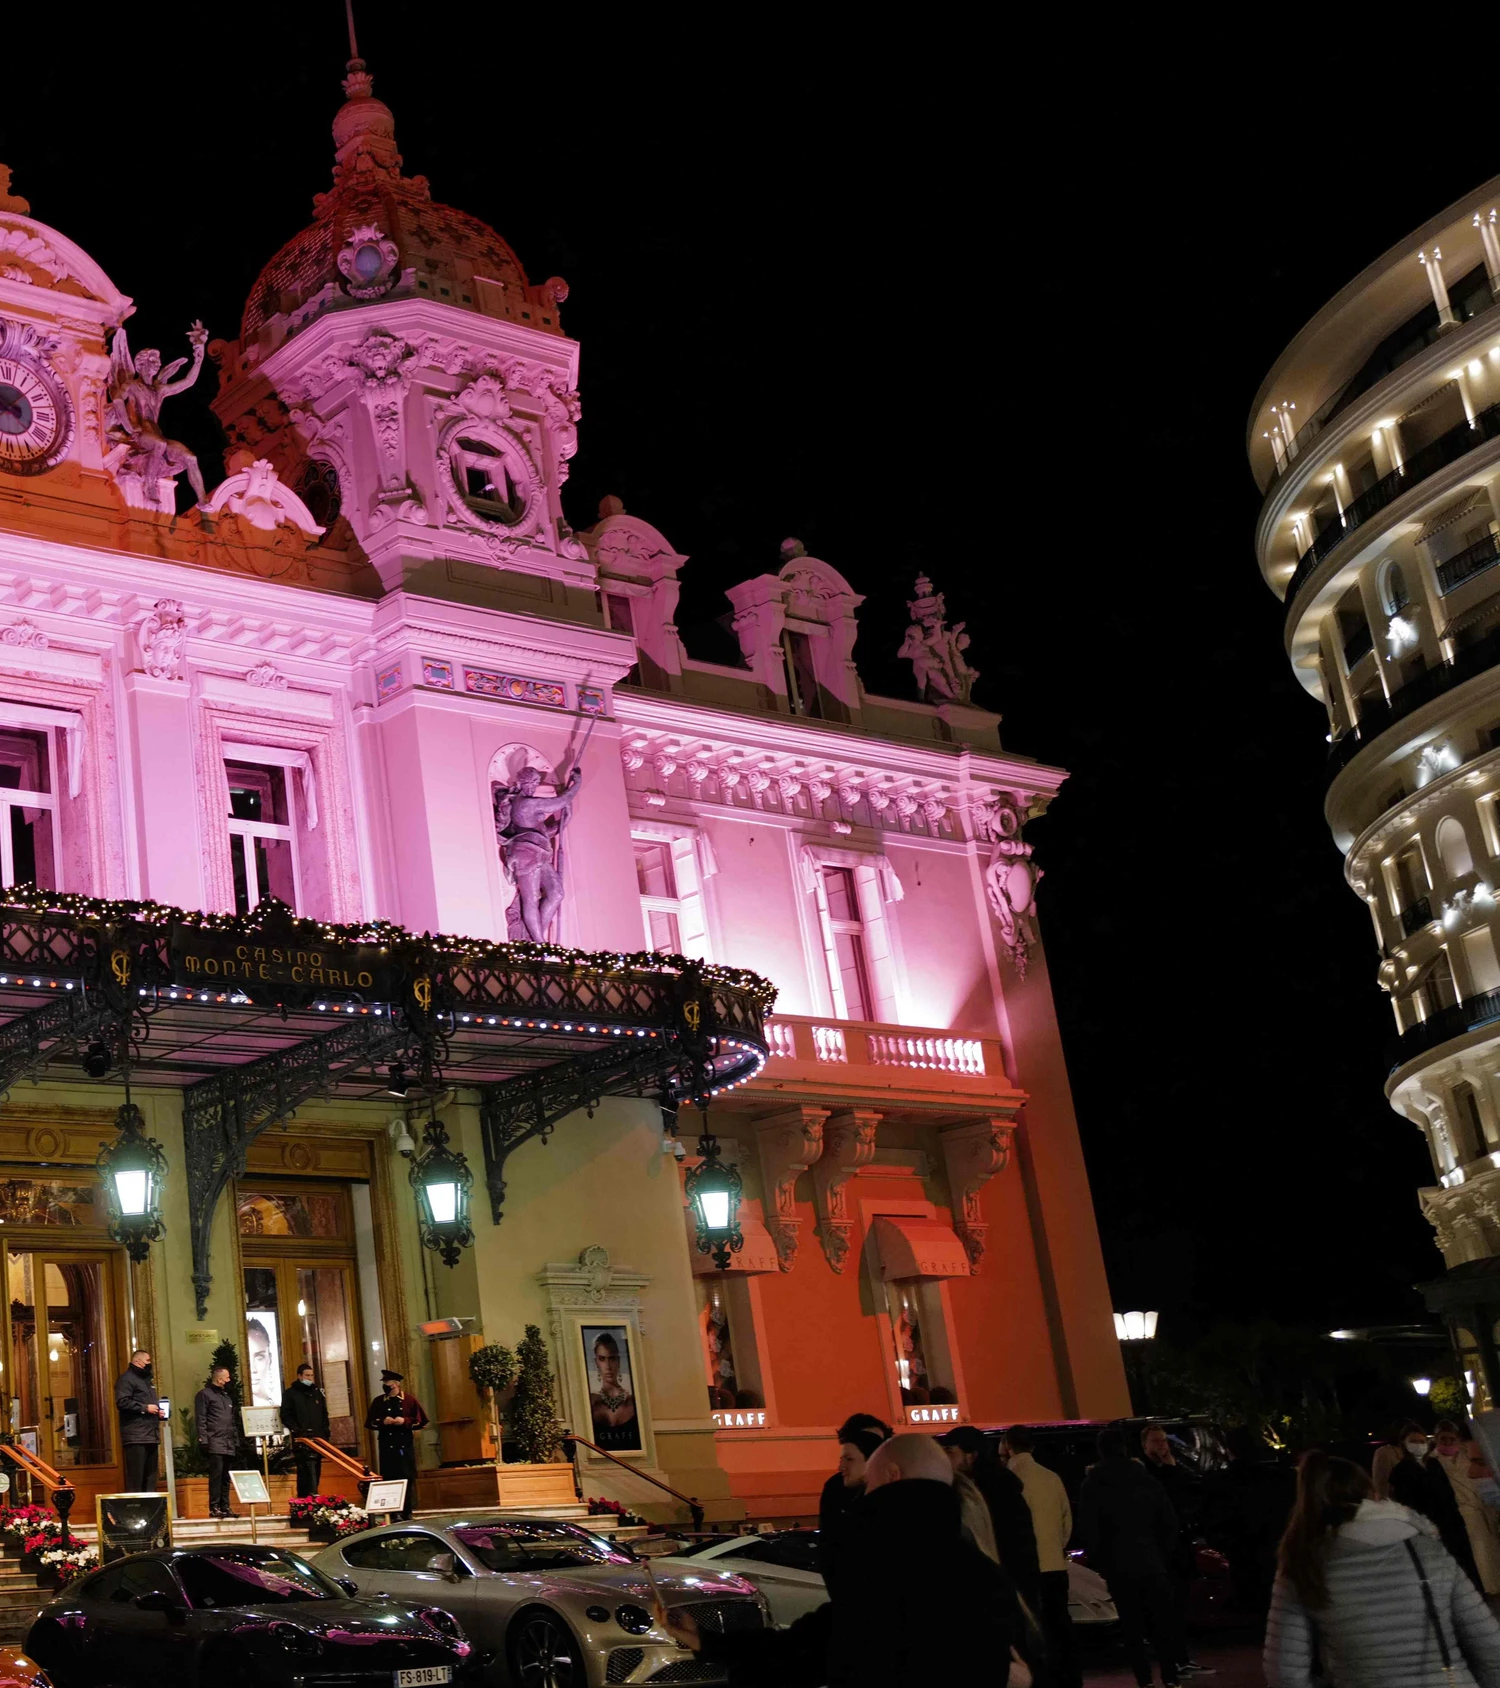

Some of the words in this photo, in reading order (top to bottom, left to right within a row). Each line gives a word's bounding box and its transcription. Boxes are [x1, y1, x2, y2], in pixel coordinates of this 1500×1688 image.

[235, 945, 323, 967] CASINO
[736, 1256, 777, 1269] RAFF
[921, 1261, 967, 1273] GRAFF
[911, 1408, 959, 1422] GRAFF
[600, 1431, 633, 1440] GRAFF
[399, 1667, 447, 1685] FS-819-LT
